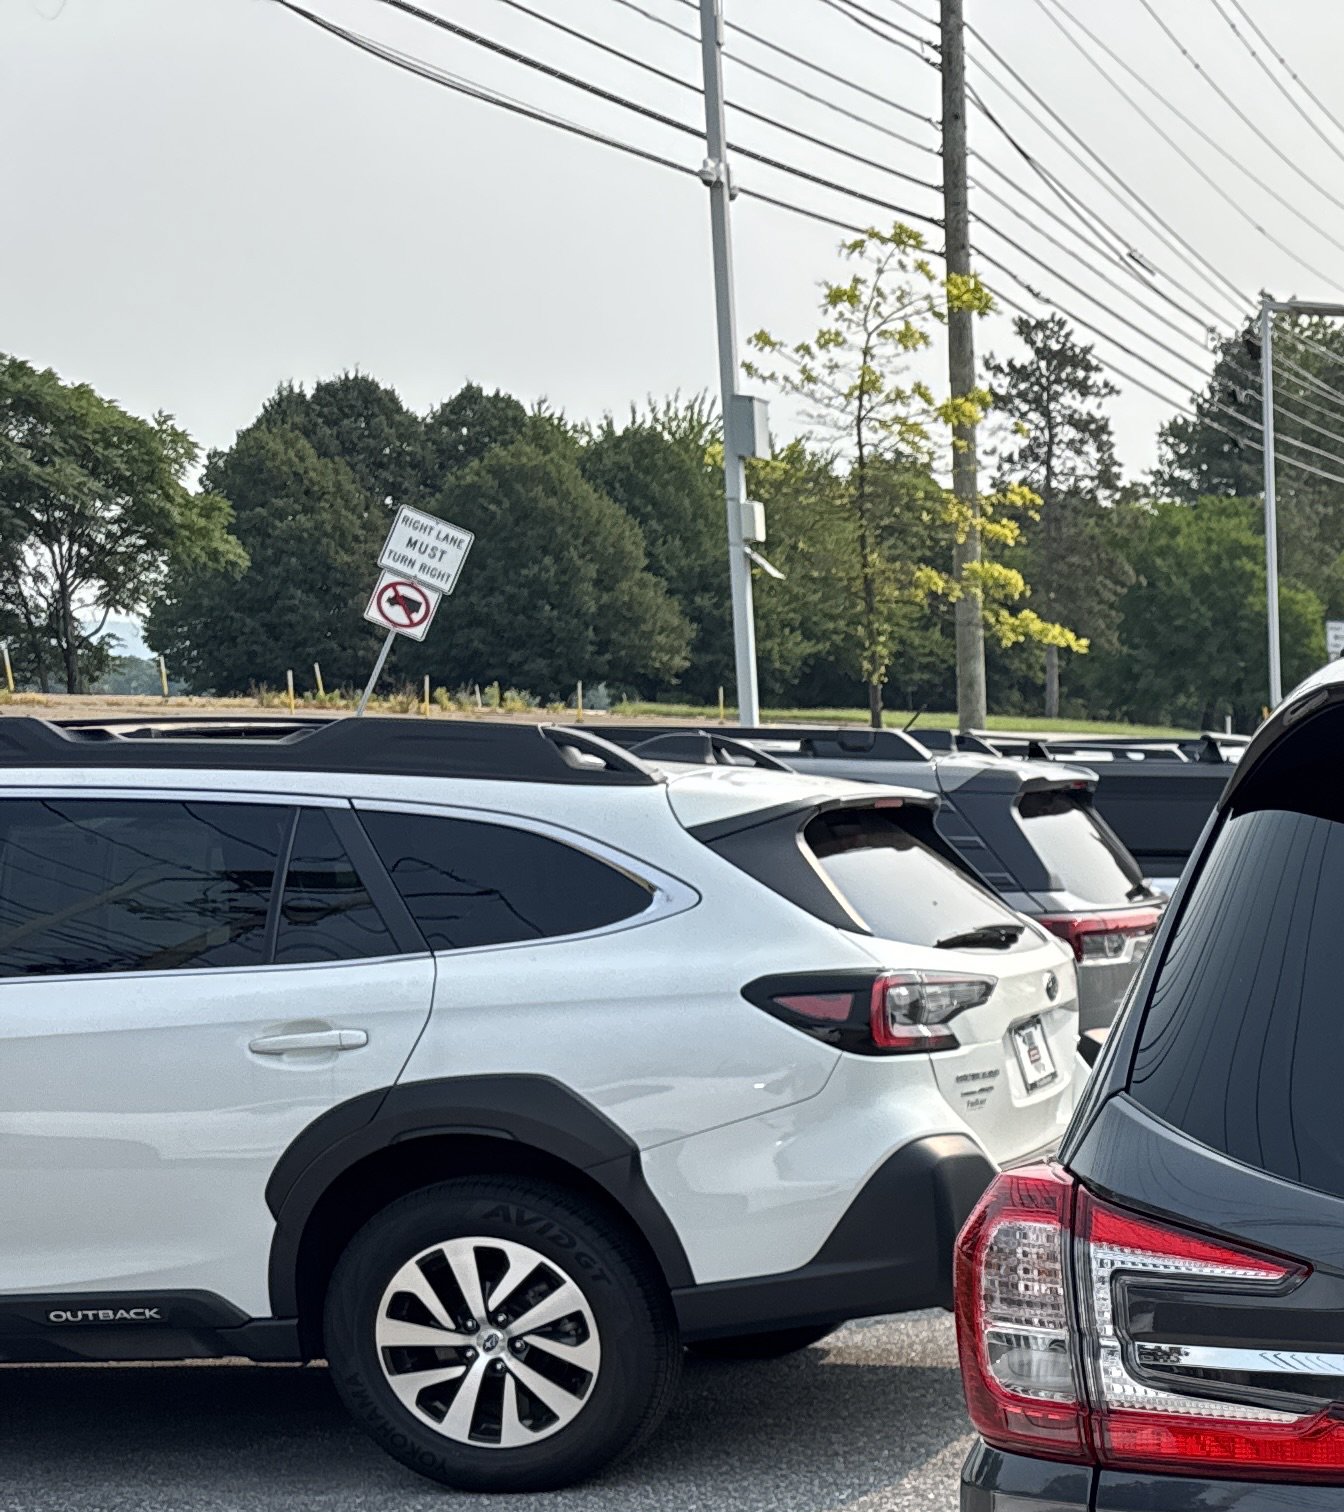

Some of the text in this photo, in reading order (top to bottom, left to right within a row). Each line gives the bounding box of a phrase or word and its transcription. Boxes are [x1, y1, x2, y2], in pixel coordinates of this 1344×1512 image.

[401, 515, 465, 550] RIGHT LANE
[405, 536, 448, 563] MUST
[387, 549, 451, 584] TURN RIGHT
[49, 1308, 161, 1323] OUTBACK
